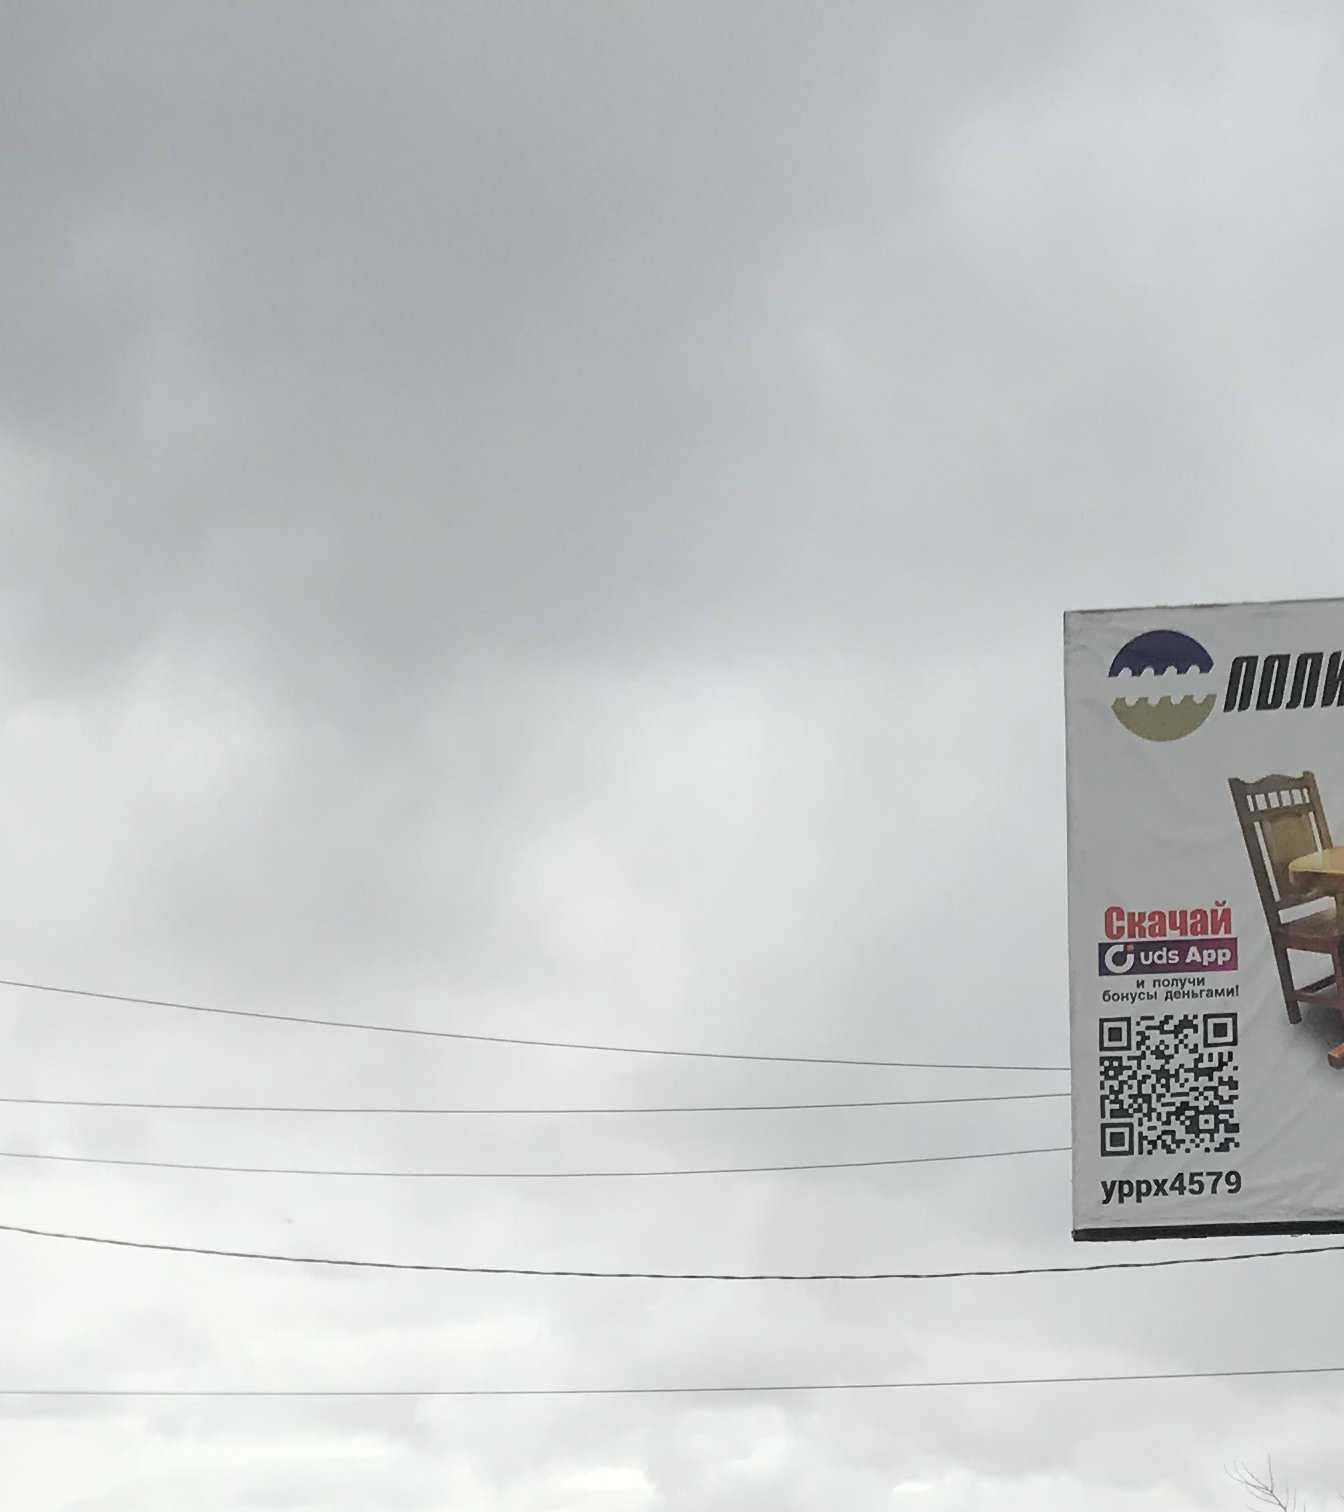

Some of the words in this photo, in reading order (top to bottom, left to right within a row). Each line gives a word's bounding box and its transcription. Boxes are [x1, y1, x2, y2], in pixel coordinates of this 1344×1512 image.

[1105, 900, 1232, 940] Скачай
[1140, 948, 1179, 965] uds
[1185, 946, 1232, 966] App
[1136, 979, 1145, 989] и
[1152, 977, 1205, 990] получи
[1102, 990, 1158, 1004] бонусы
[1164, 984, 1240, 1001] деньгами!
